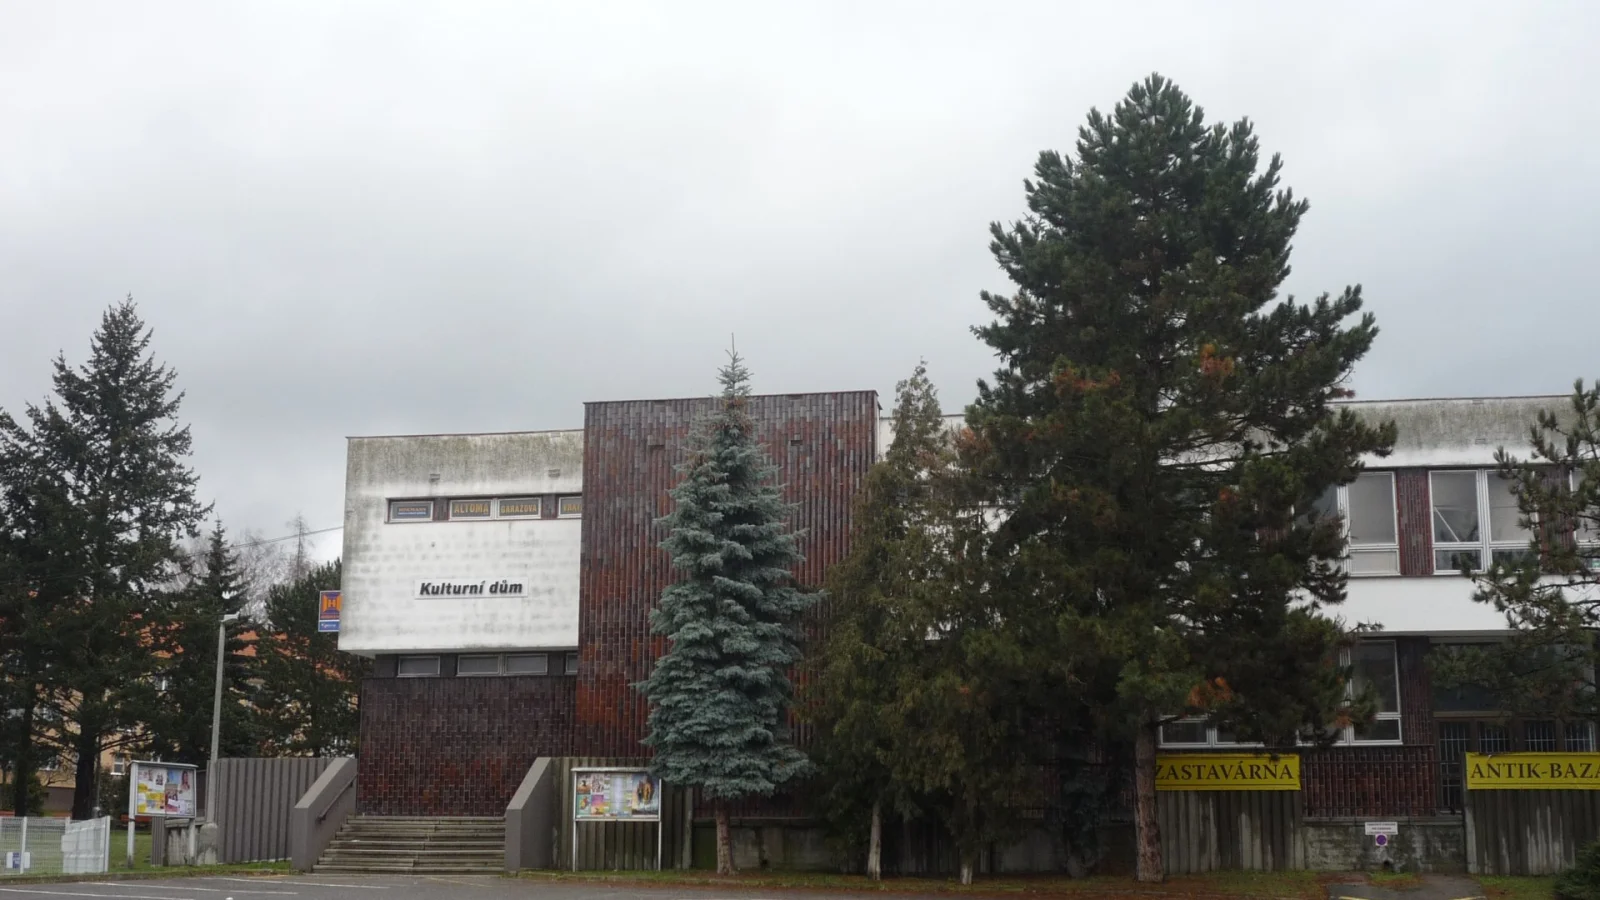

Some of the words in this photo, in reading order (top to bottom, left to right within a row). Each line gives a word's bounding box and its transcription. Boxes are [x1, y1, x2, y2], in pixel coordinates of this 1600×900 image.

[419, 580, 486, 596] Kulturní
[489, 579, 522, 594] dům
[1155, 761, 1293, 780] ZASTAVÁRNA
